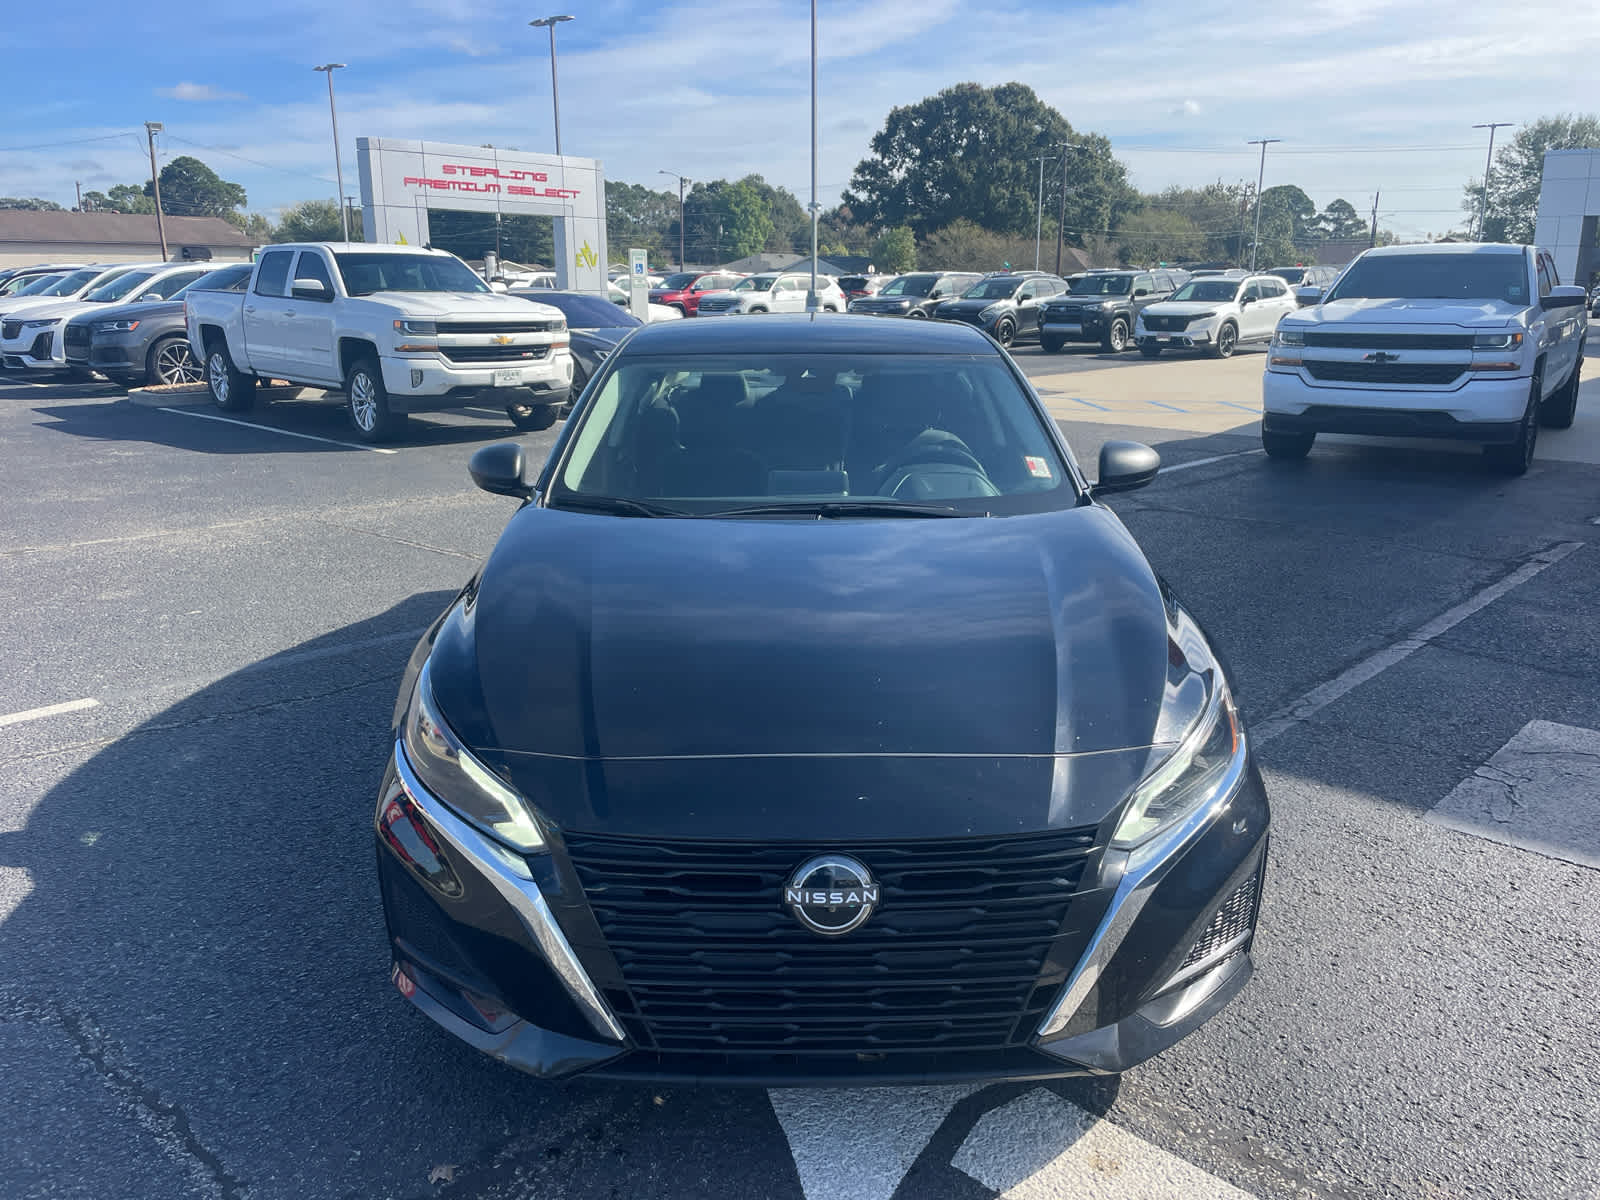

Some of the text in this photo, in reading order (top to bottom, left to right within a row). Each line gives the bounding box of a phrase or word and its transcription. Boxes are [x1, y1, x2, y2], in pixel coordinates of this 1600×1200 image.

[442, 164, 548, 182] STERLING
[403, 176, 581, 199] PREMIUM SELECT
[787, 889, 877, 904] NISSAN
